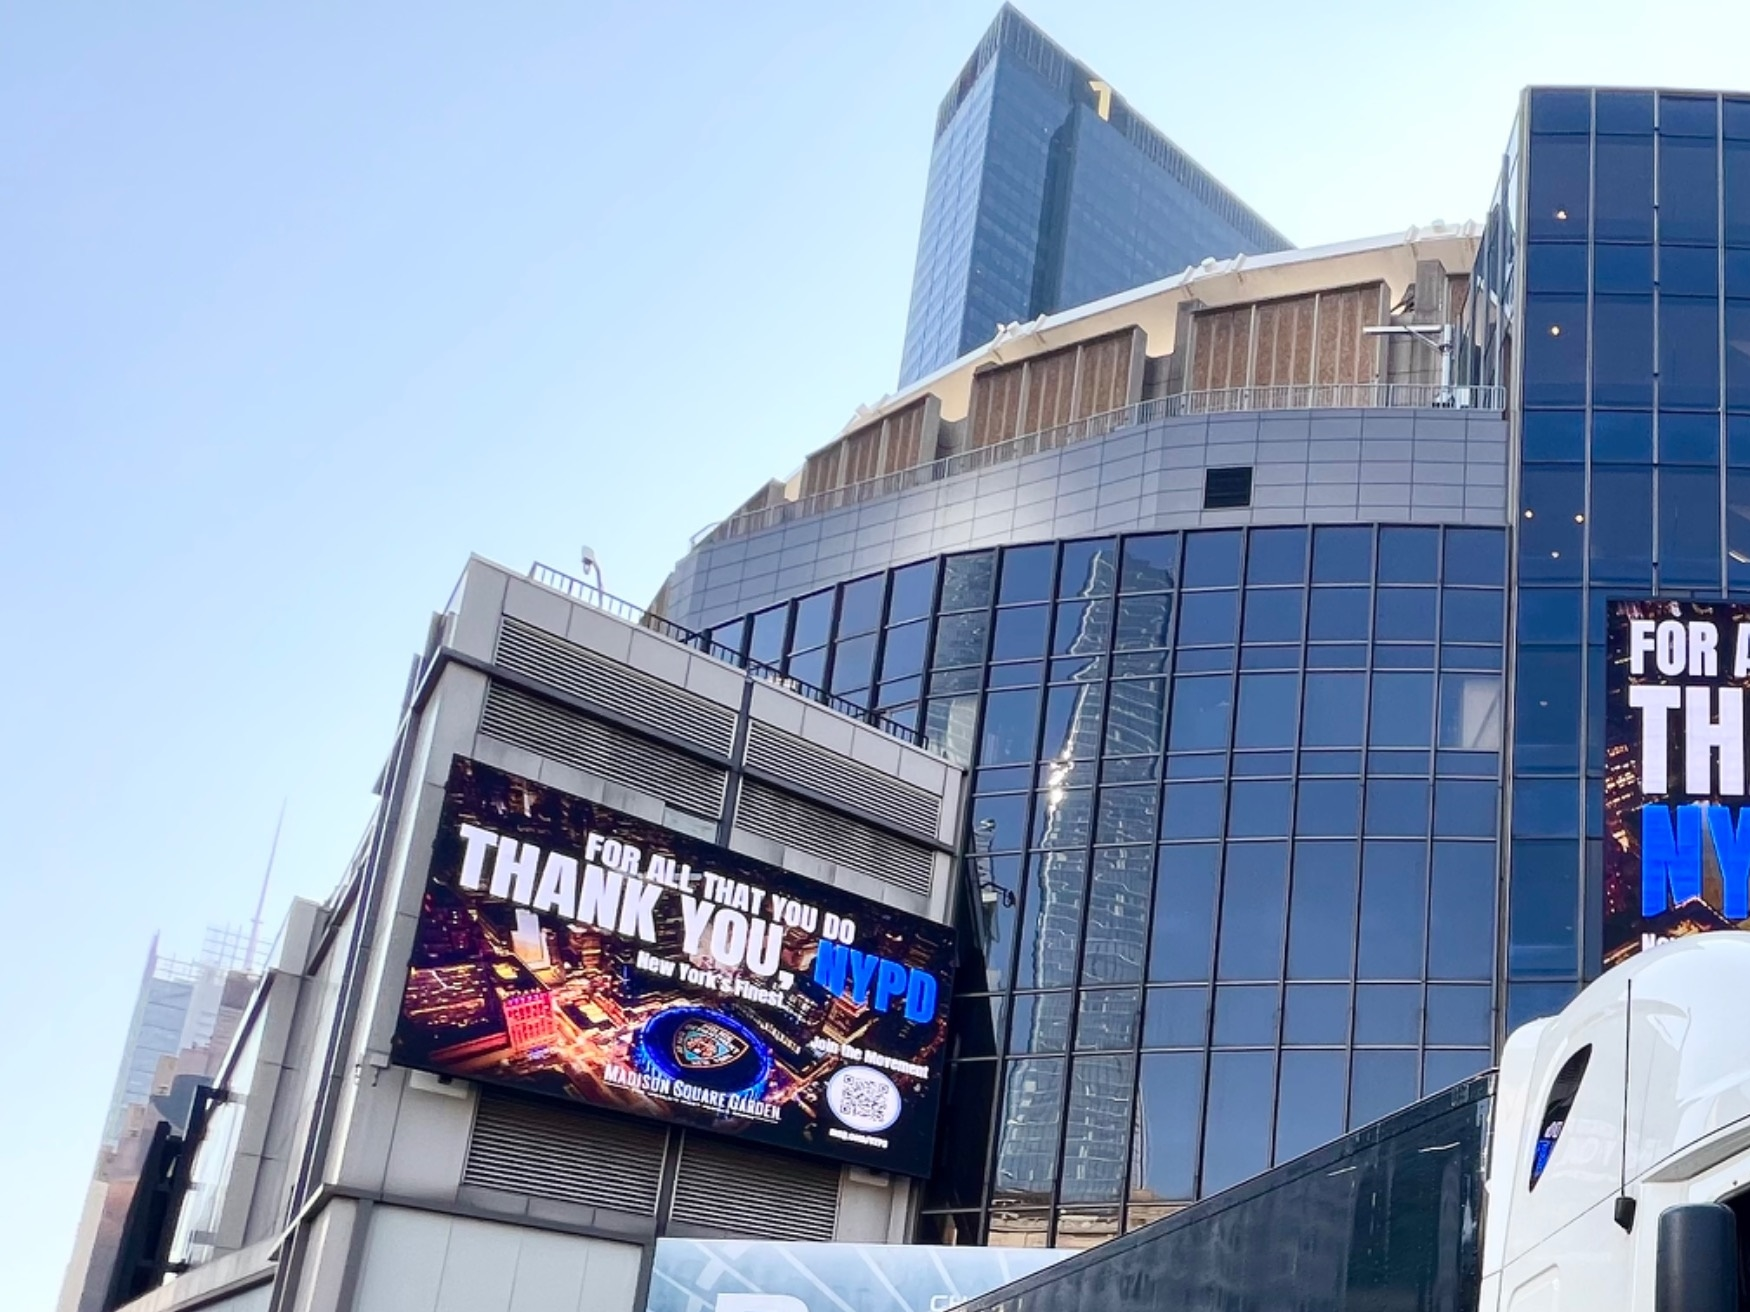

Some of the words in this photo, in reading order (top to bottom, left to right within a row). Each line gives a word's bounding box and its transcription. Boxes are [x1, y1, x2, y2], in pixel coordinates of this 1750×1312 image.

[1629, 620, 1718, 678] FOR
[458, 823, 662, 943] THANK
[681, 893, 795, 991] YOU,
[584, 832, 641, 876] FOR
[646, 853, 694, 893] ALL
[703, 871, 767, 916] THAT
[771, 893, 818, 934] YOU
[822, 913, 856, 945] DO
[636, 949, 675, 978] New
[678, 962, 733, 993] York's
[813, 938, 938, 1026] NYPD
[810, 1035, 840, 1055] Join
[841, 1043, 864, 1061] the
[864, 1049, 930, 1079] Movement
